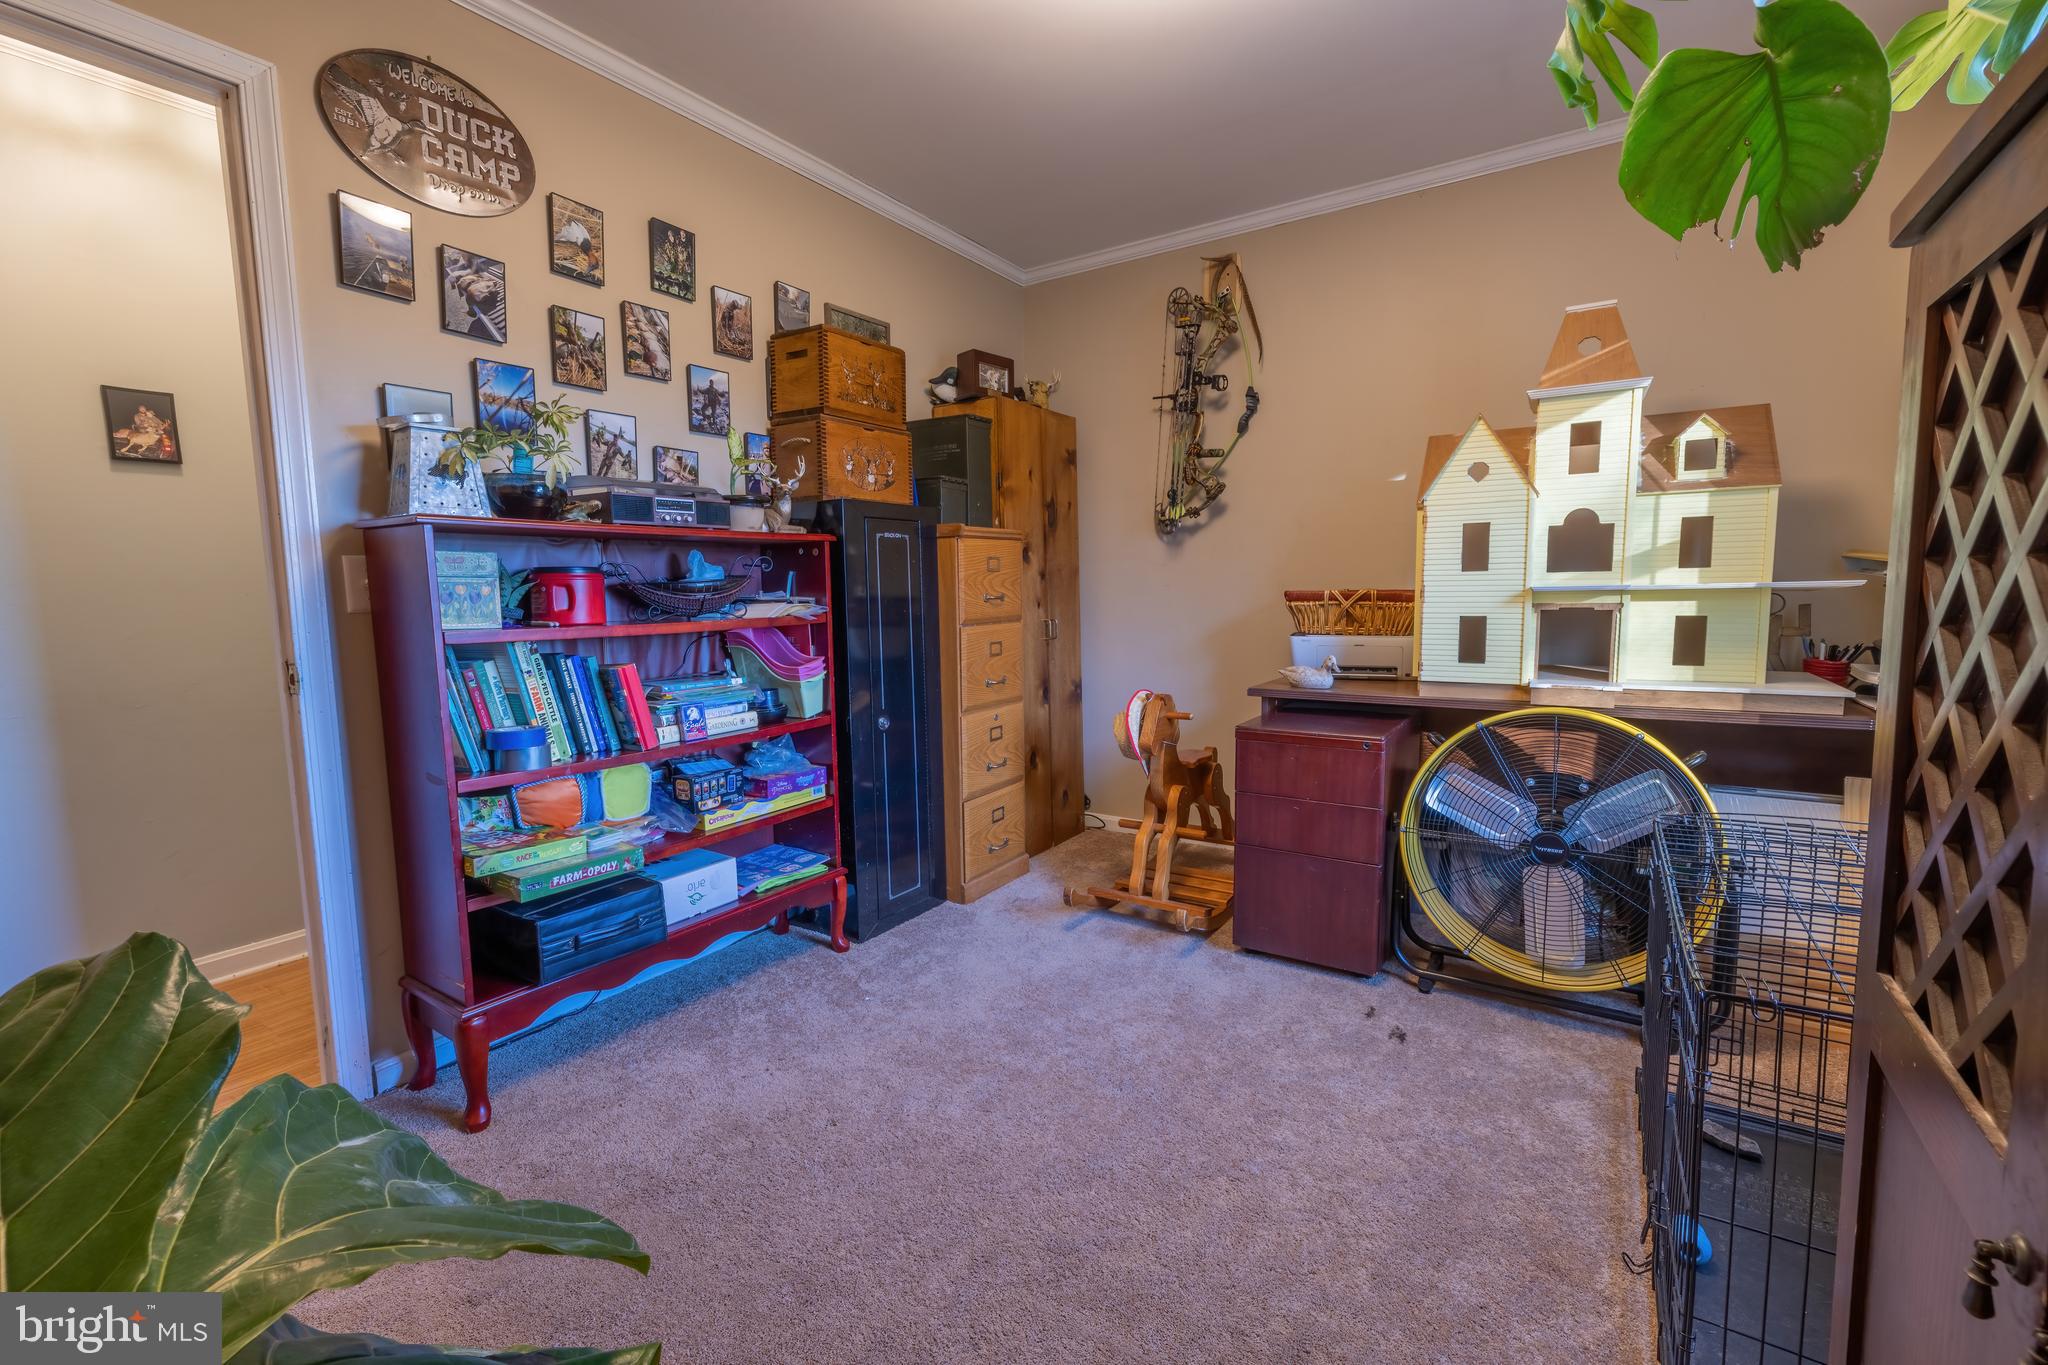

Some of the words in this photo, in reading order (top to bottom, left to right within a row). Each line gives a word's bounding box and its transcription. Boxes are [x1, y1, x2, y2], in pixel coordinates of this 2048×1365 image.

[418, 97, 517, 160] DUCK
[420, 133, 521, 191] CAMP
[529, 686, 545, 712] FARM
[533, 657, 550, 699] GRASS-FED
[545, 696, 558, 723] CATTLE
[552, 860, 619, 887] FARM-OPOLY
